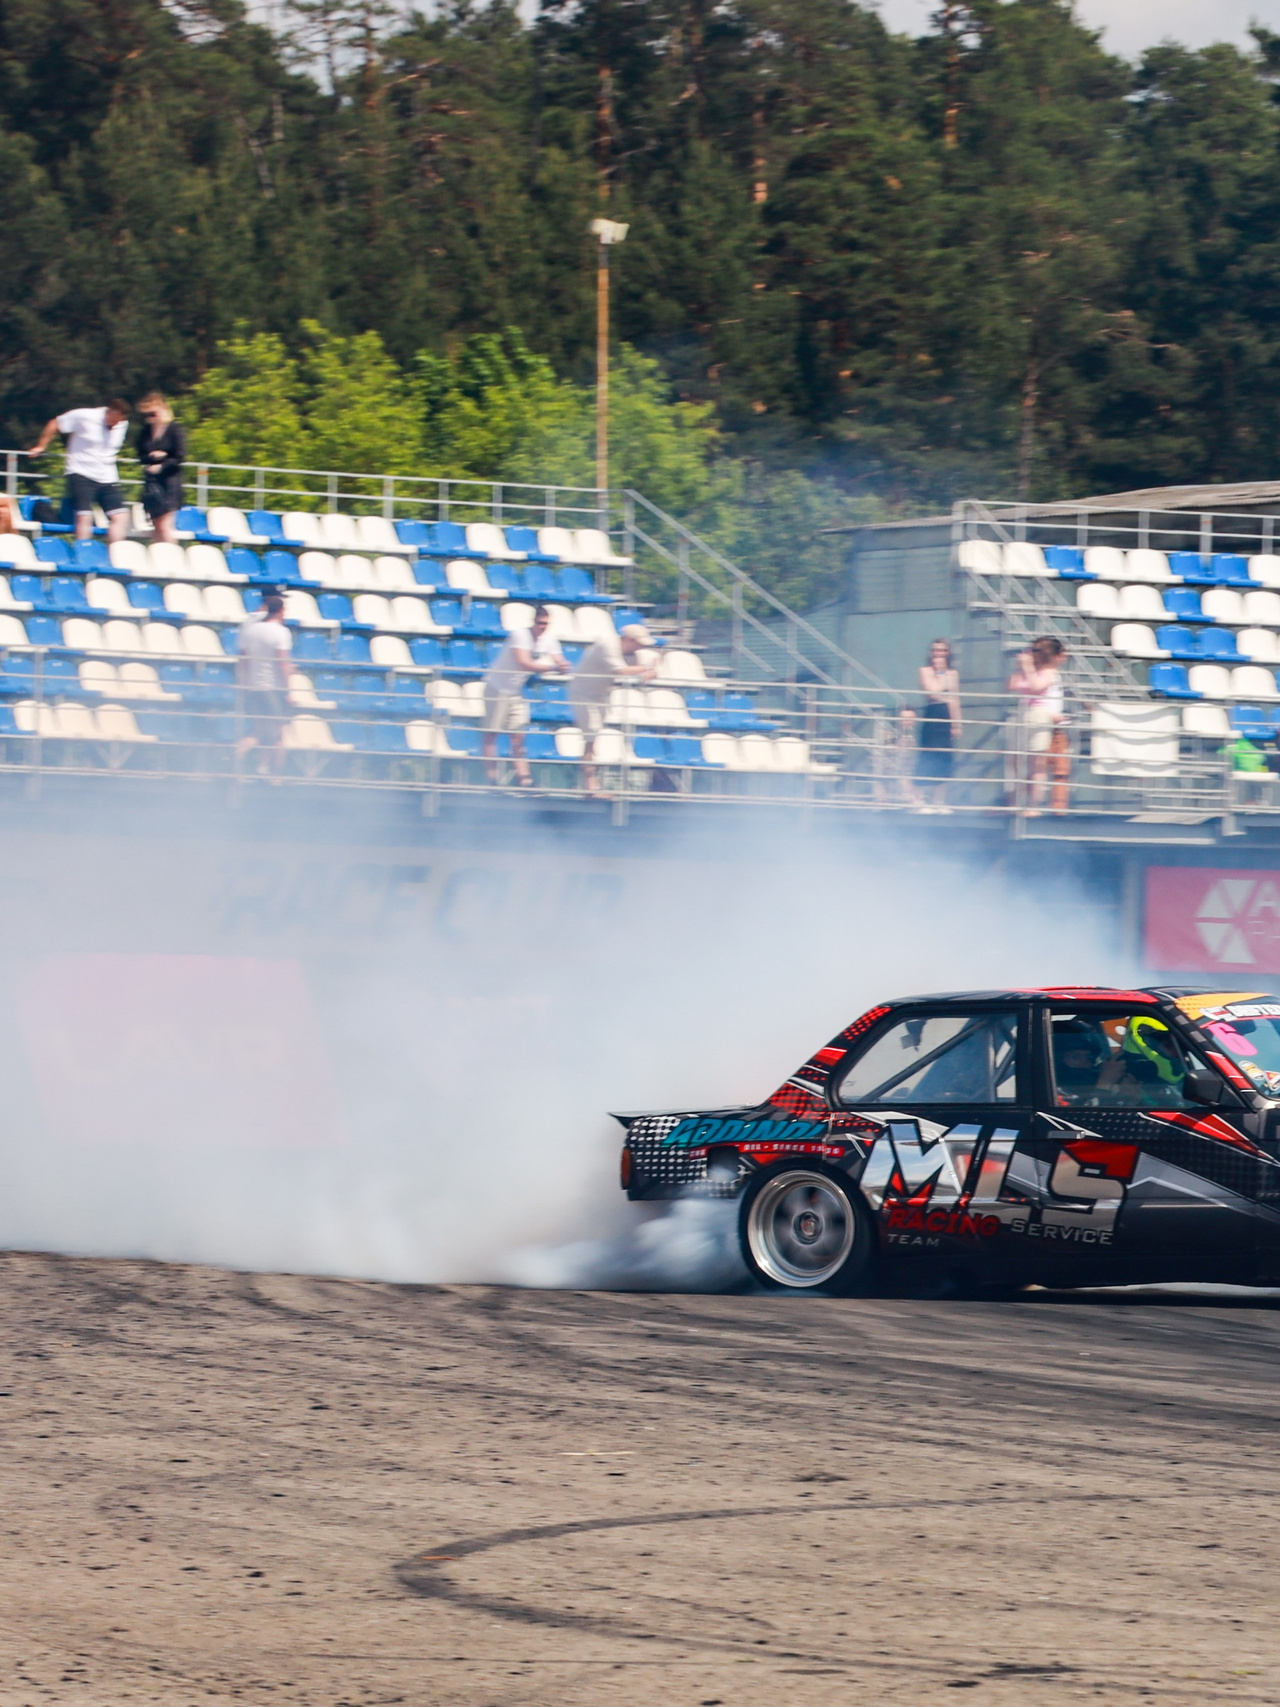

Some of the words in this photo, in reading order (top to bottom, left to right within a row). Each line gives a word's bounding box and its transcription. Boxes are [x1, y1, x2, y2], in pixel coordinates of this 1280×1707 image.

[1208, 1022, 1258, 1056] 6
[886, 1207, 1001, 1237] RACING
[1011, 1219, 1114, 1246] SERVICE
[888, 1233, 940, 1247] TEAM
